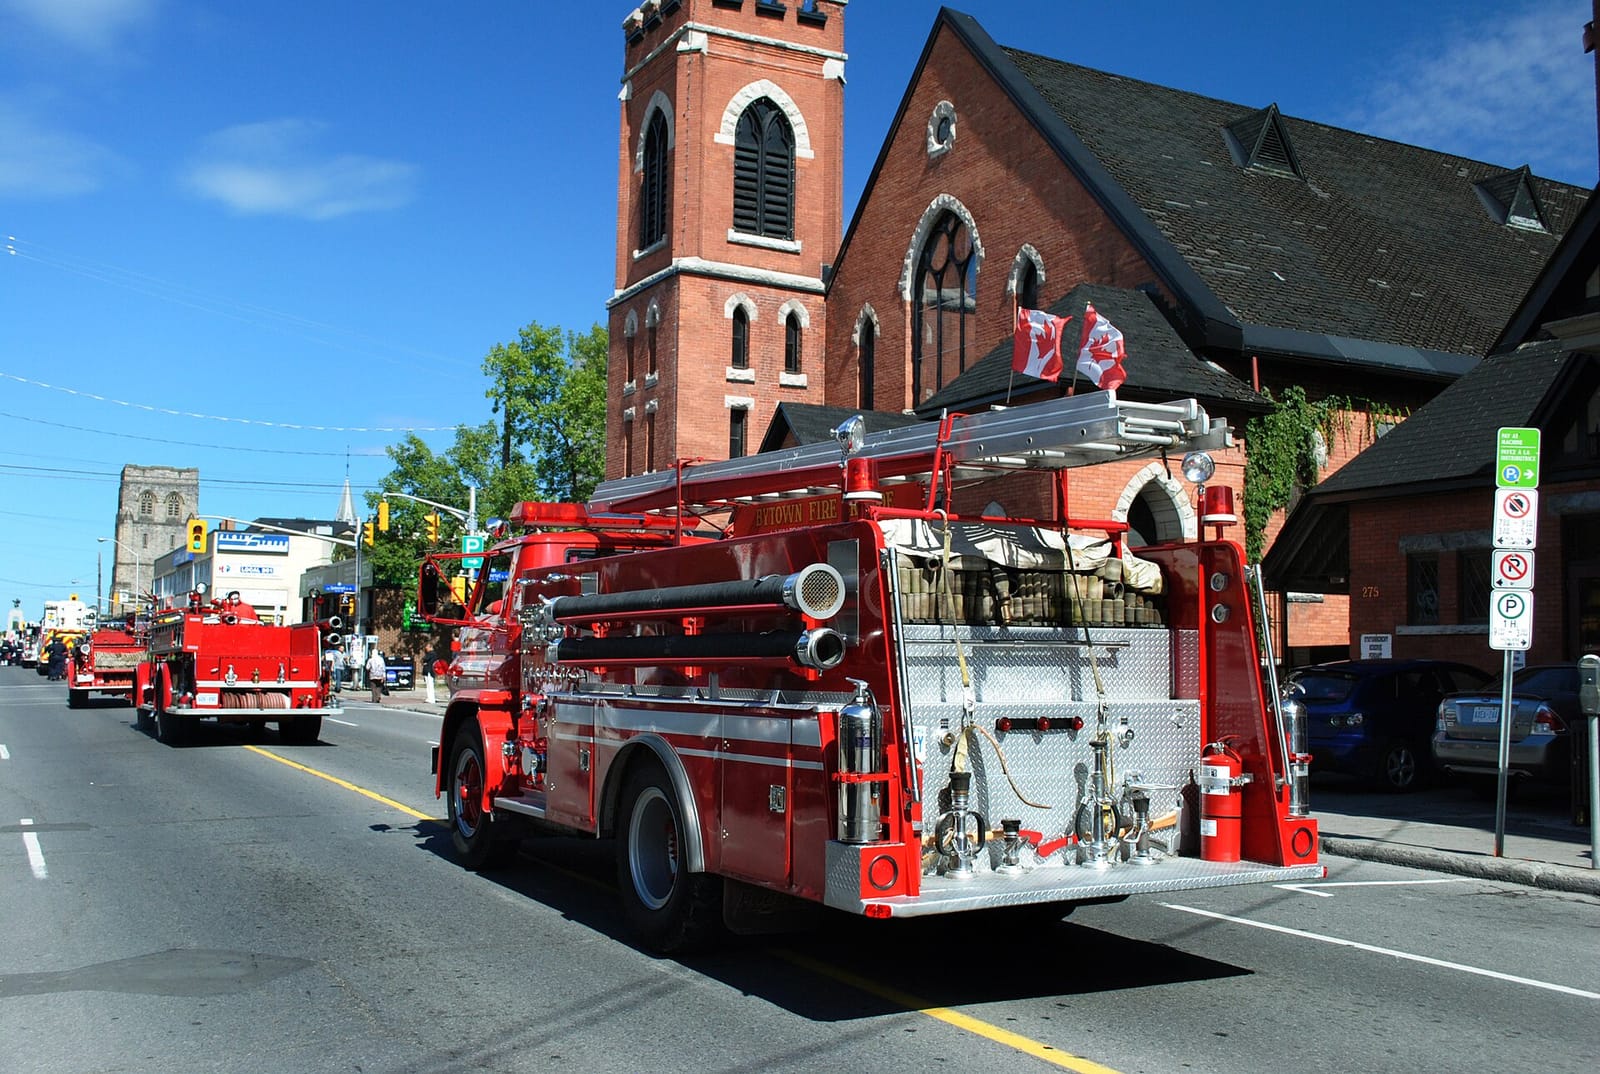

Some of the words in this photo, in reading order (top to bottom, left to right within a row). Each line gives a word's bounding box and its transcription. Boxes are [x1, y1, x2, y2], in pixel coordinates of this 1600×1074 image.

[756, 503, 803, 527] BYTOWN
[809, 498, 838, 521] FIRE
[466, 540, 480, 555] P
[1362, 586, 1380, 598] 275
[1505, 599, 1518, 613] P
